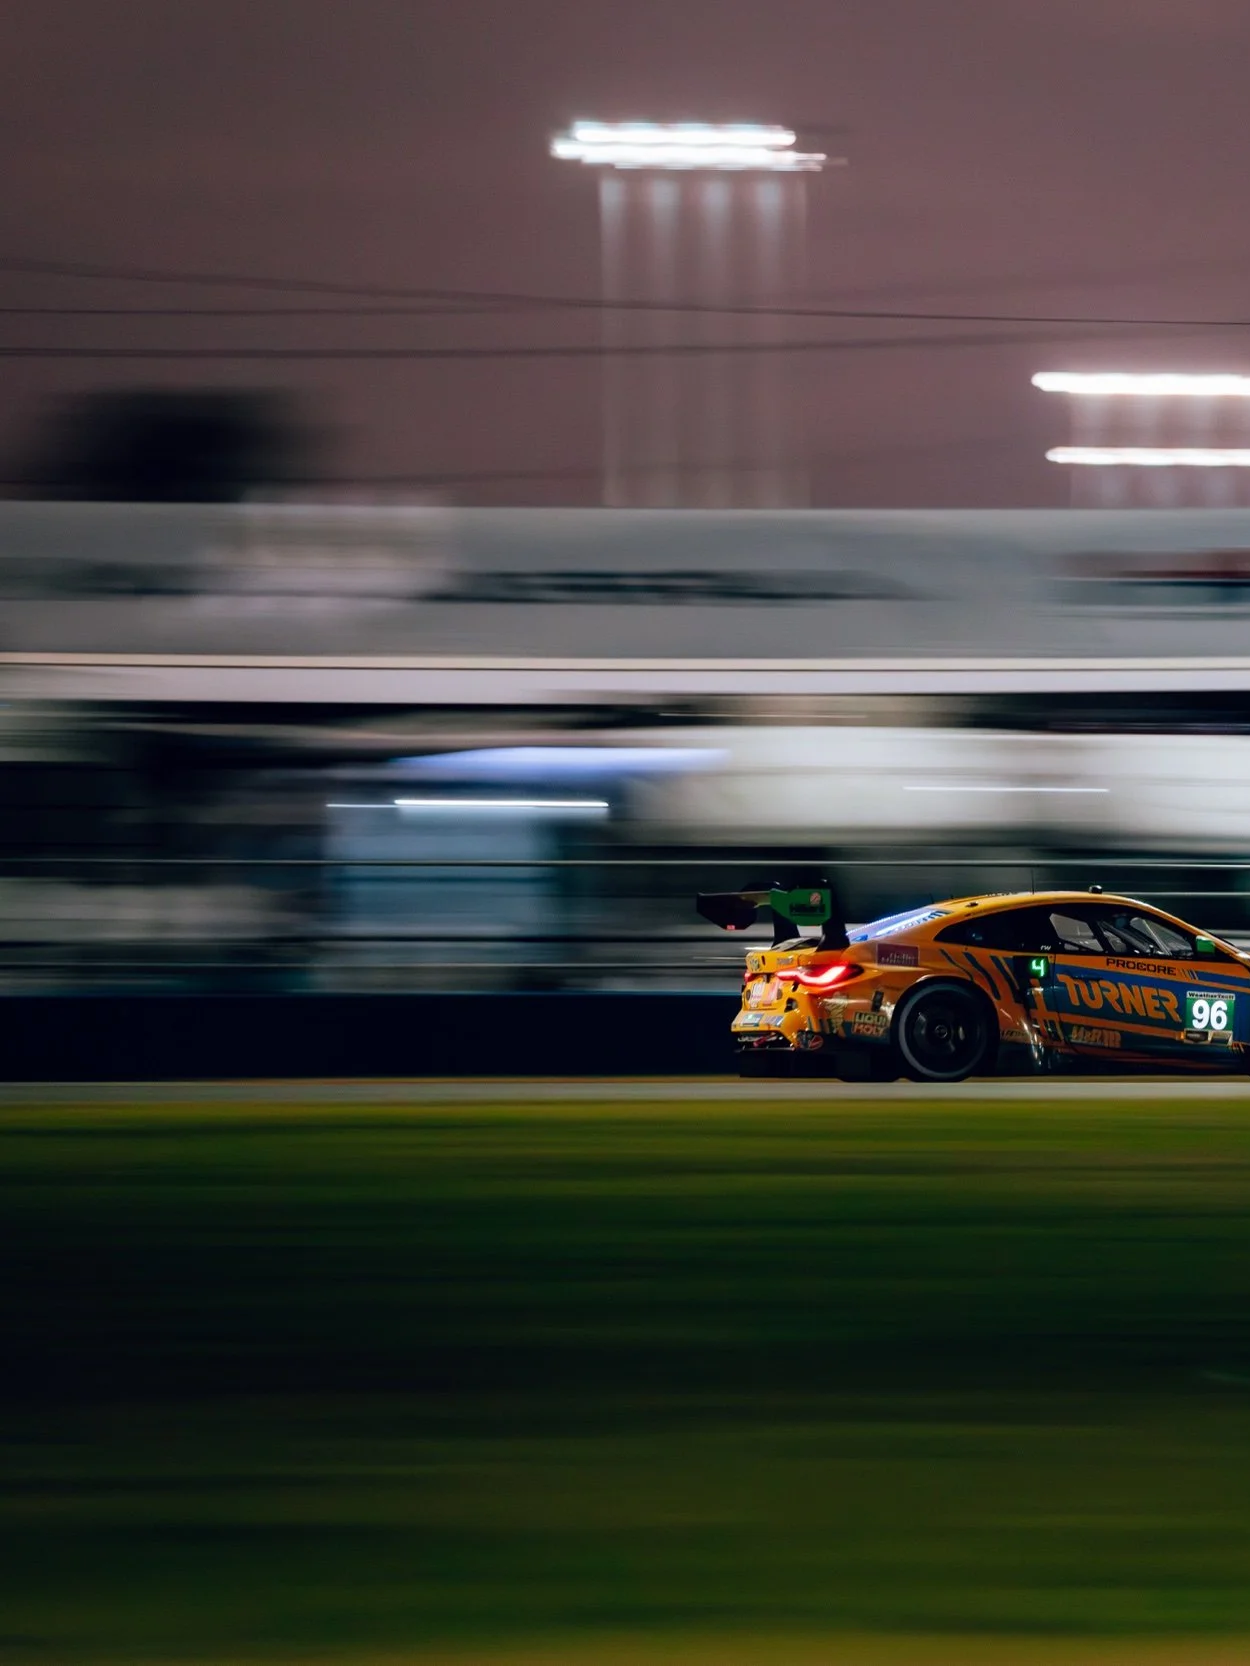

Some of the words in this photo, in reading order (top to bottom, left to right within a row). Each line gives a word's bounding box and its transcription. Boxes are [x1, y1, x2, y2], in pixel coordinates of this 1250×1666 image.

[1031, 959, 1045, 977] 4
[1106, 957, 1177, 976] PROCORE
[1056, 973, 1182, 1023] TURNER
[855, 1012, 888, 1026] LIQUI
[1192, 999, 1228, 1030] 96
[853, 1023, 886, 1037] MOLY
